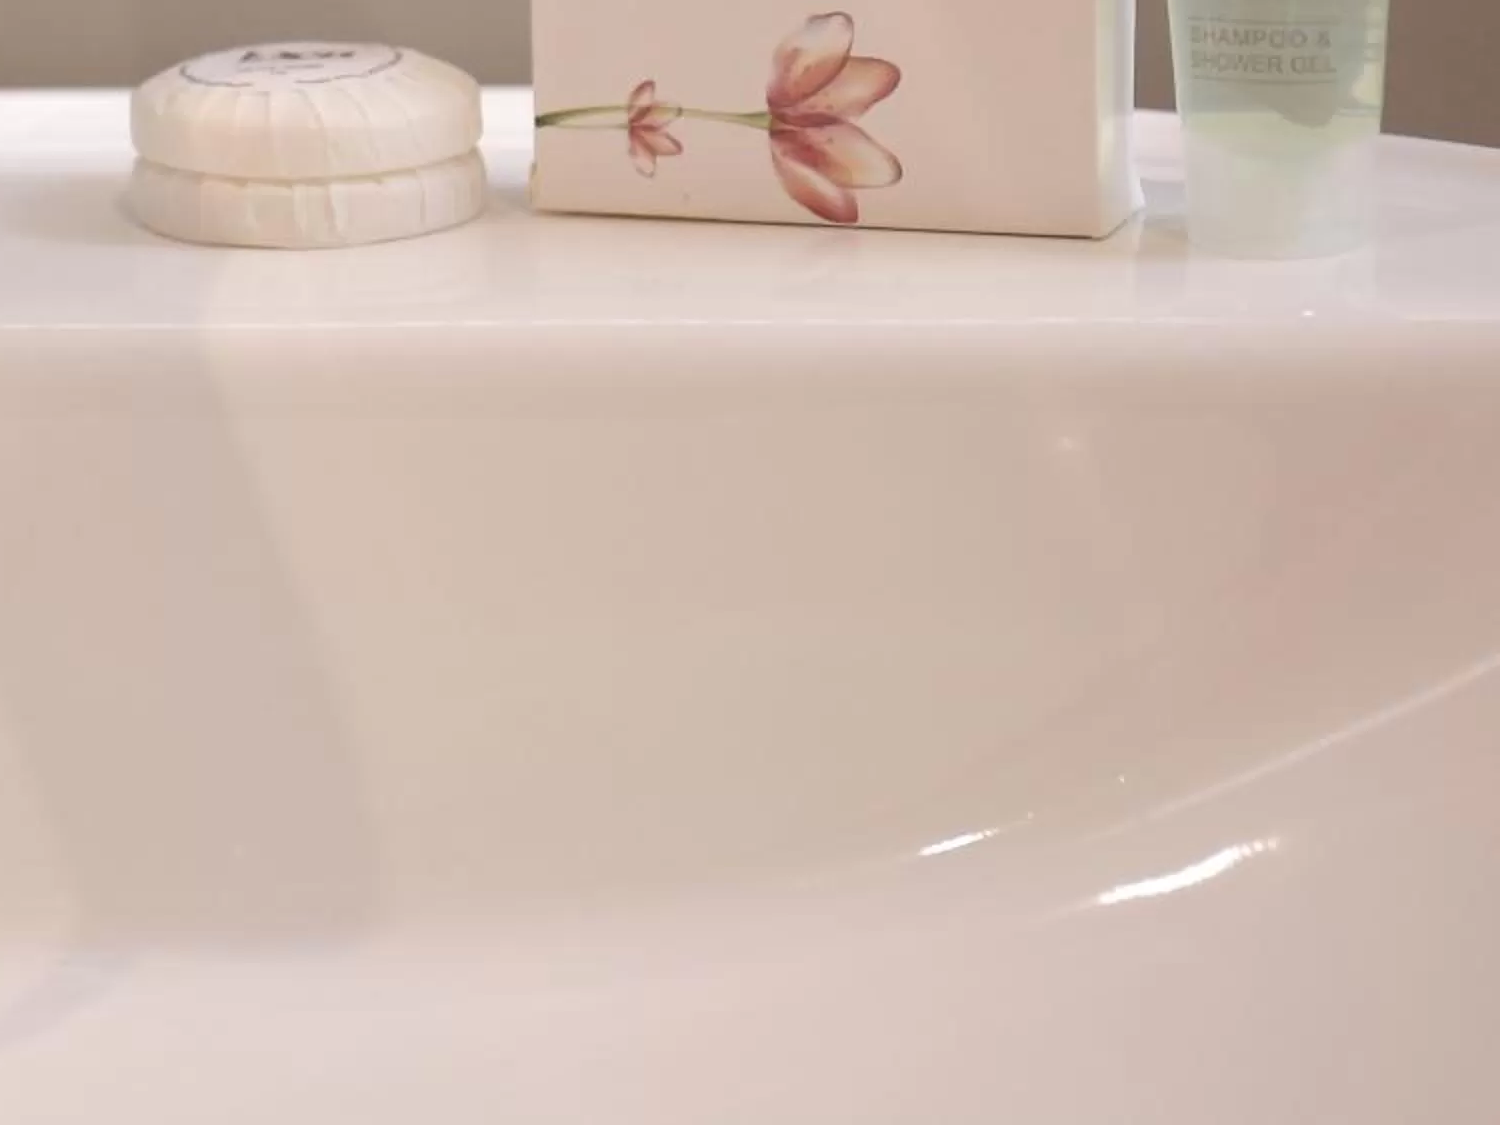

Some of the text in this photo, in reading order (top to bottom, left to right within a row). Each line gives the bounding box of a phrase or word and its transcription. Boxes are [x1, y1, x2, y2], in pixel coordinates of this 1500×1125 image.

[1190, 26, 1331, 48] SHAMPOO &
[1190, 50, 1284, 74] SHOWER
